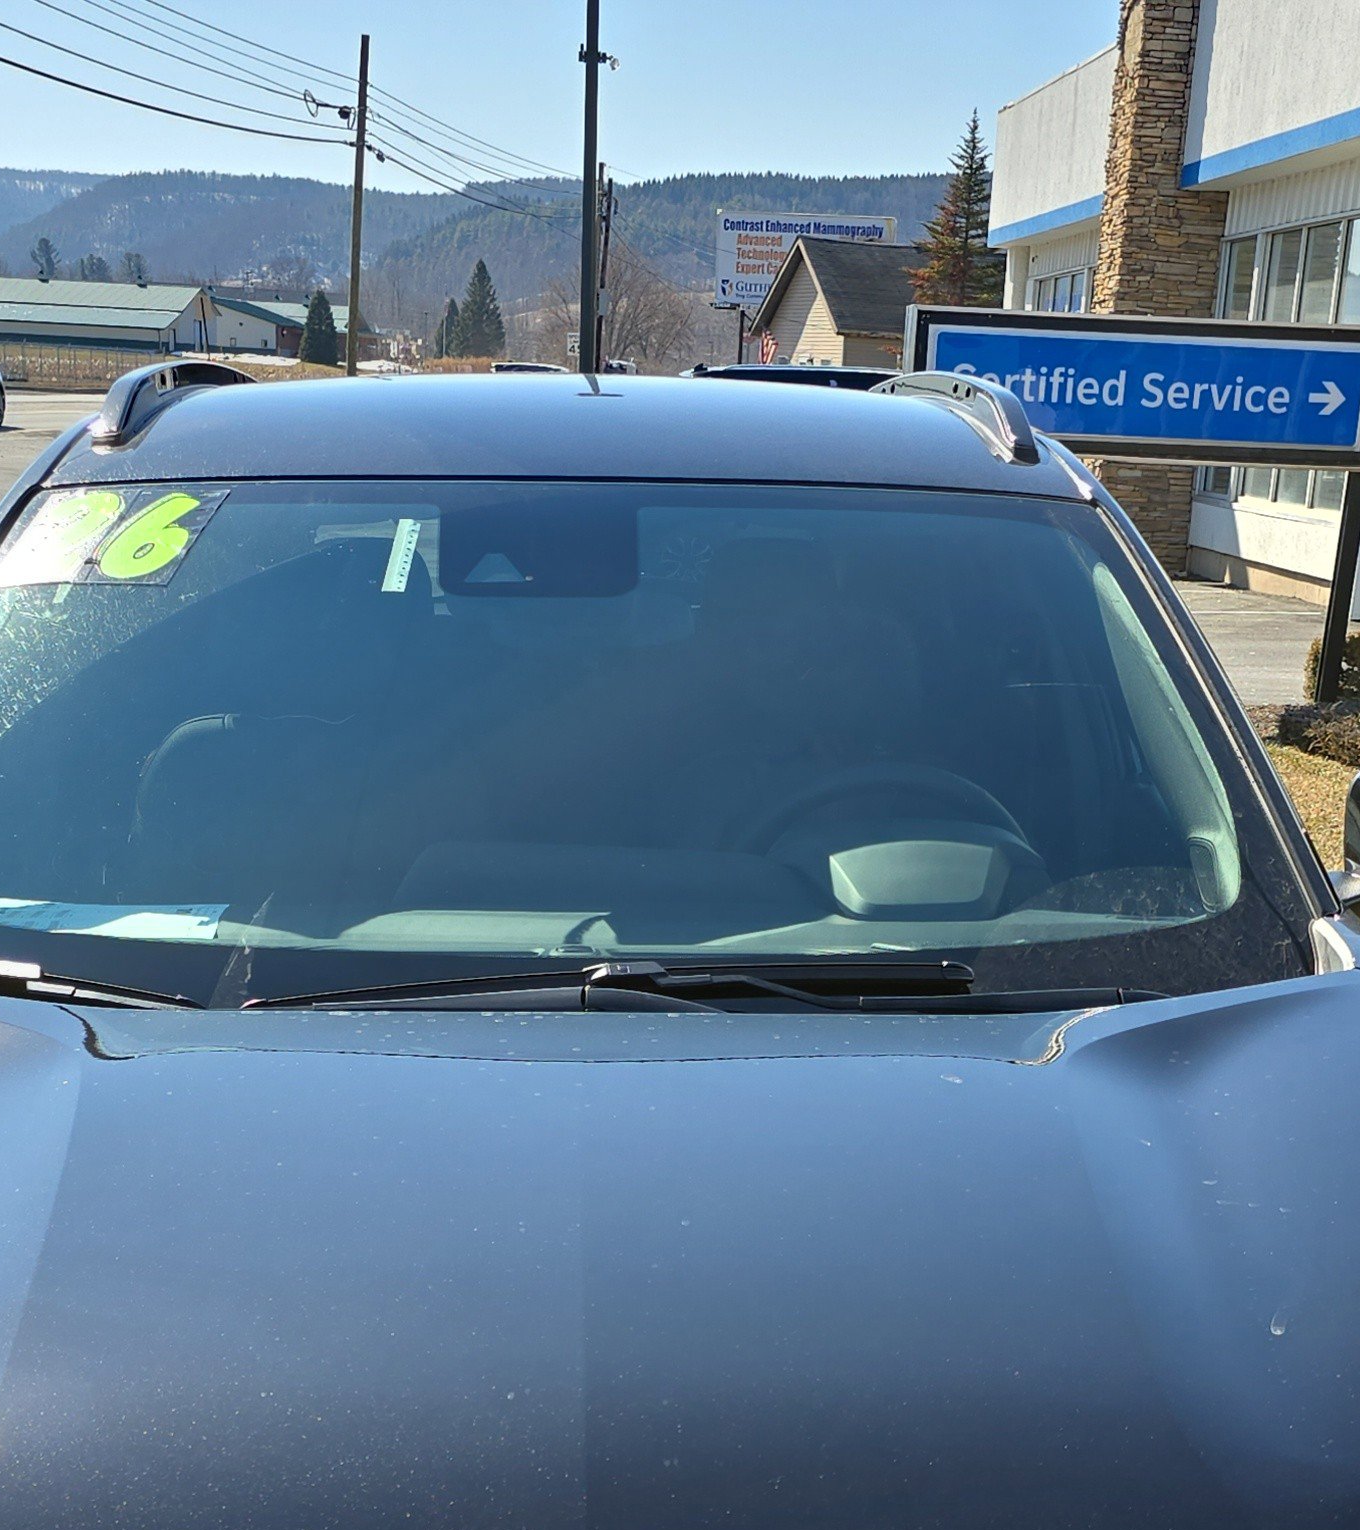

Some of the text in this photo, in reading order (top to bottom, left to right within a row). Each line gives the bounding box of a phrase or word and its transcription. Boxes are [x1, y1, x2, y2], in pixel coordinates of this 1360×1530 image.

[723, 218, 884, 239] Contrast Enhanced Mammography
[736, 234, 782, 246] Advanced
[736, 262, 779, 275] Expert Ca
[1140, 372, 1290, 413] Service
